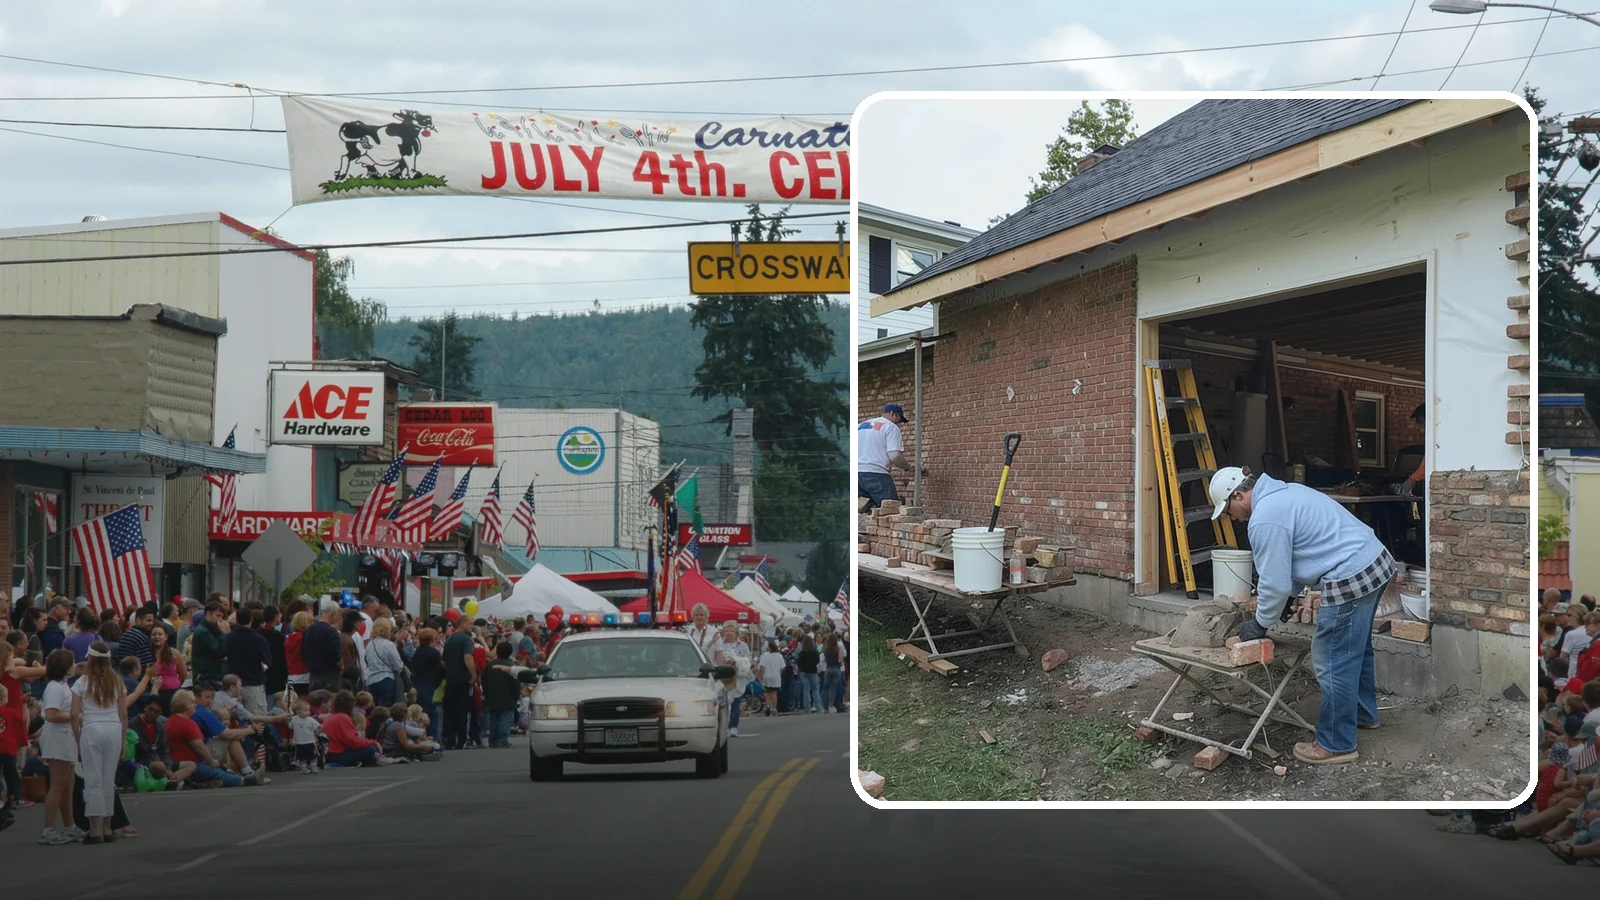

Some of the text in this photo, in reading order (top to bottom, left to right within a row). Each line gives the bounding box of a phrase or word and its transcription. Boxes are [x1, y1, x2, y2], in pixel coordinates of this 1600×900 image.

[481, 141, 605, 192] JULY
[632, 150, 746, 198] 4th.
[696, 254, 850, 280] CROSSWA
[282, 379, 373, 420] ACE
[405, 409, 485, 422] CEDAR LOG
[283, 421, 371, 437] Hardware
[353, 466, 386, 480] Simpl
[95, 484, 124, 495] Vincent
[126, 486, 136, 495] de
[137, 486, 155, 495] Paul
[81, 503, 154, 522] THT
[212, 516, 331, 536] HARDARE
[688, 526, 742, 535] CRNATION
[699, 535, 730, 543] GLASS
